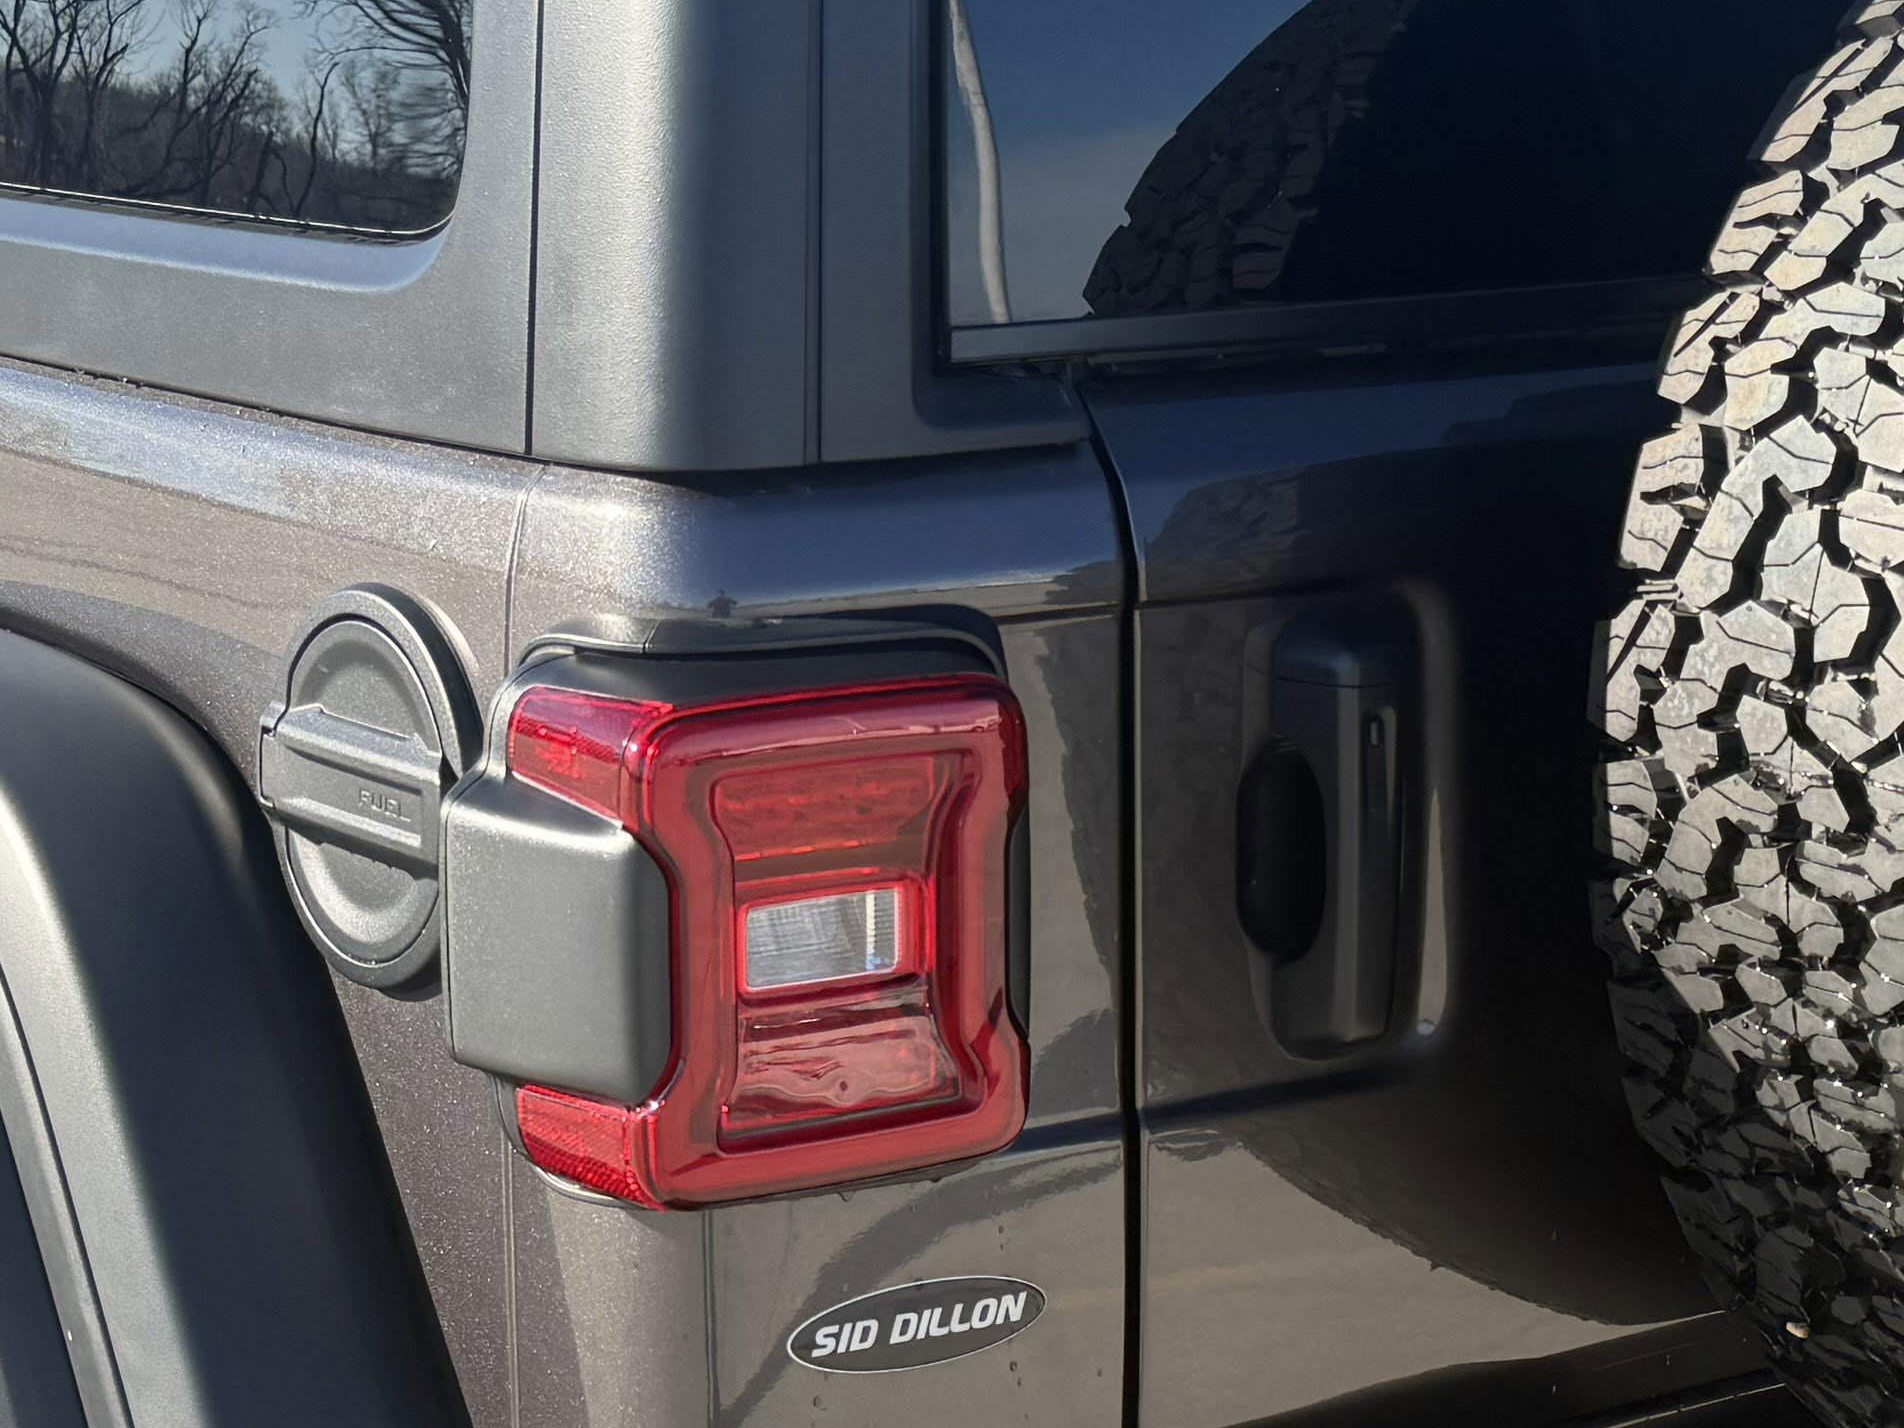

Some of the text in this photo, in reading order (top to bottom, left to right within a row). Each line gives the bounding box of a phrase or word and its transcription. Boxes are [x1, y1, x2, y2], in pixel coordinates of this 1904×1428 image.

[358, 787, 411, 822] FUEL
[810, 1289, 1028, 1359] SID DILLON
